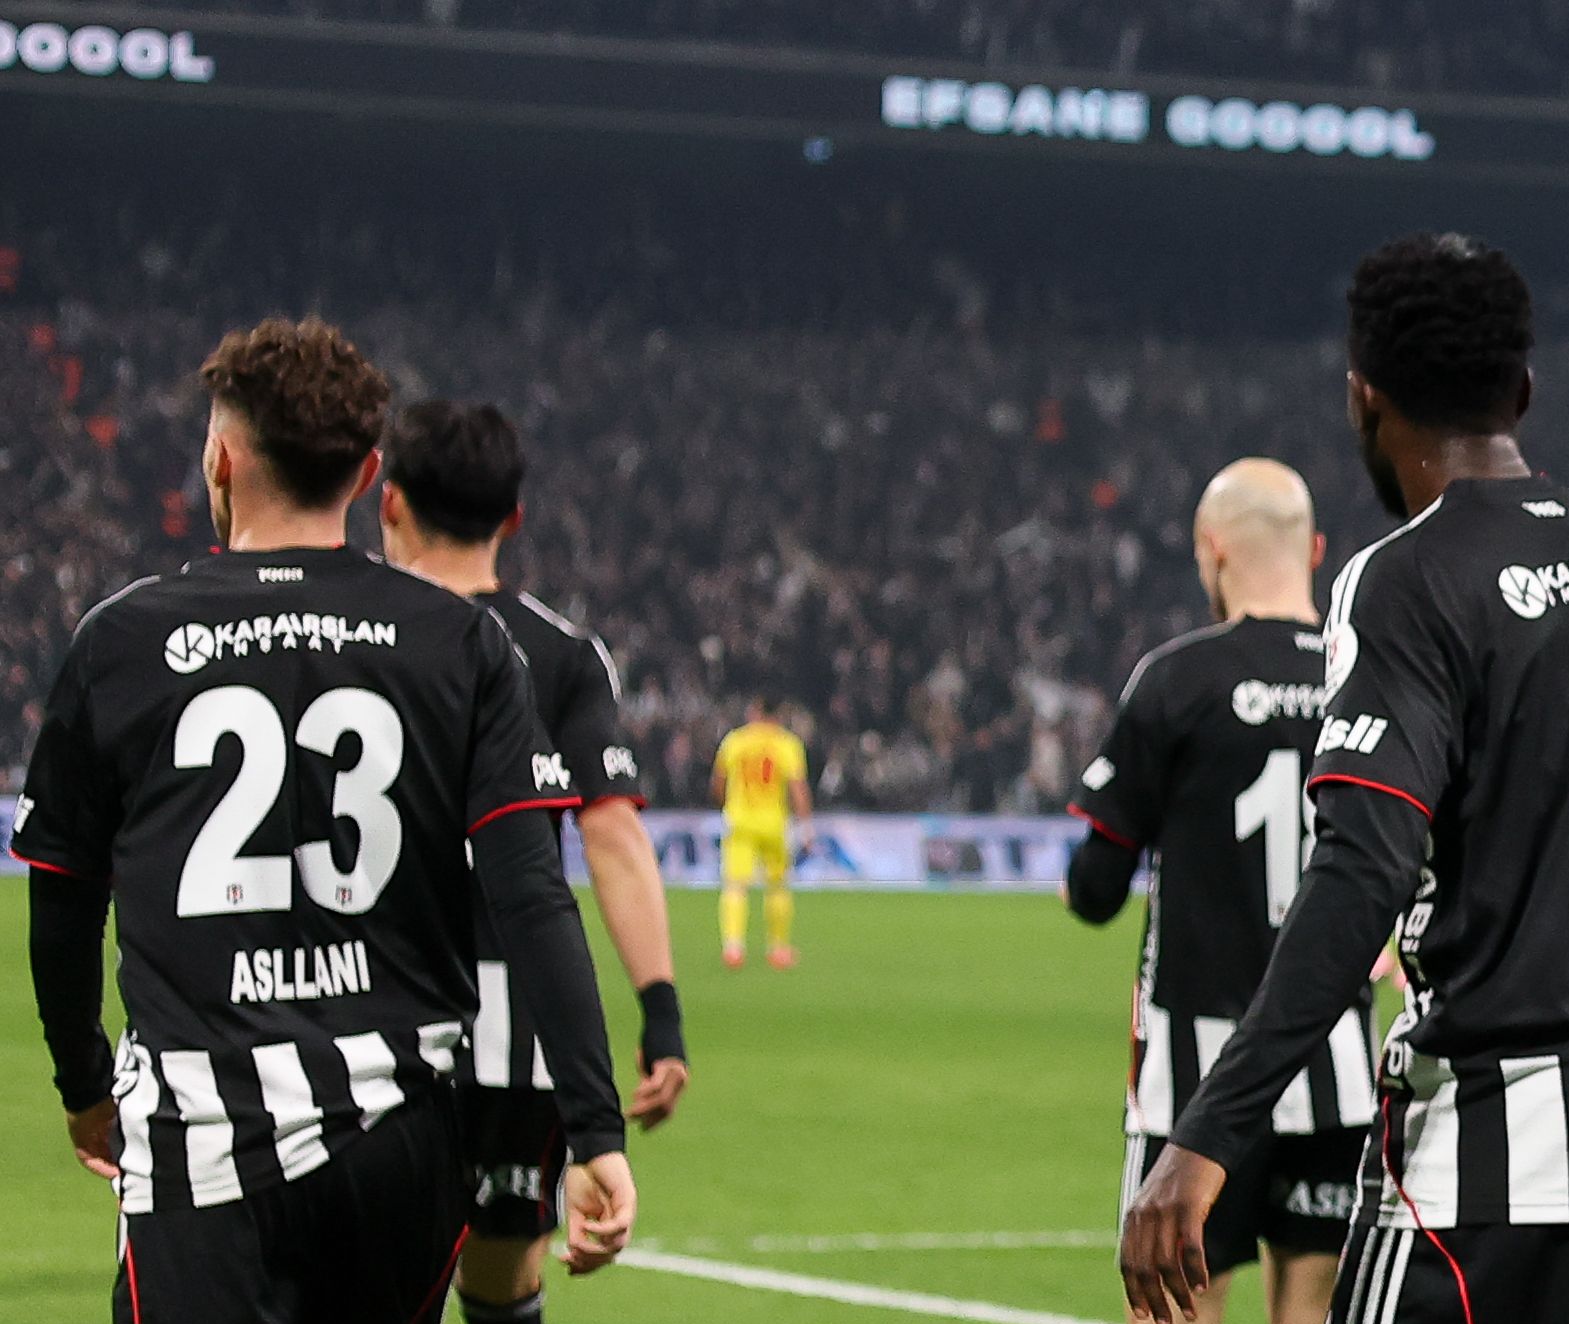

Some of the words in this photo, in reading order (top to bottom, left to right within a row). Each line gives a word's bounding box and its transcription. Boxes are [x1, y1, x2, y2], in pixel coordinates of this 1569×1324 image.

[173, 685, 403, 918] 23
[1234, 748, 1317, 928] 1
[231, 941, 370, 1003] ASLLANI
